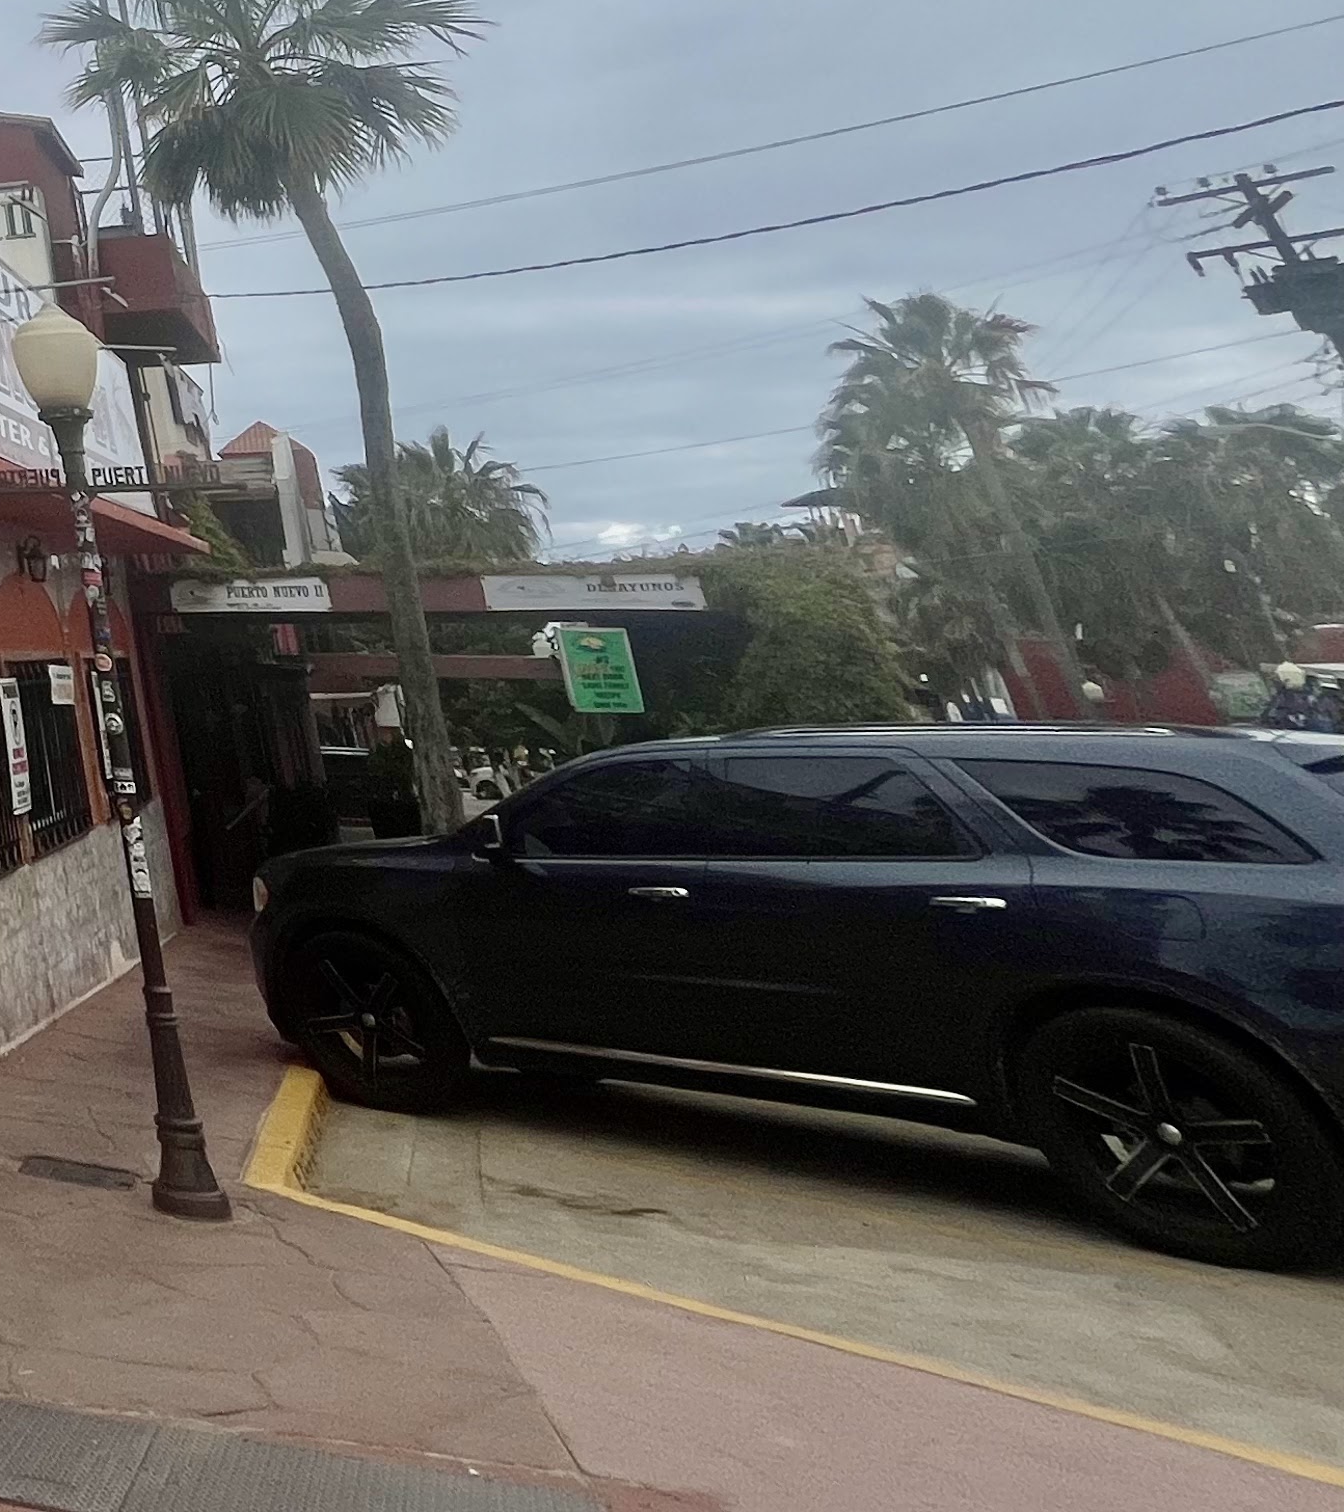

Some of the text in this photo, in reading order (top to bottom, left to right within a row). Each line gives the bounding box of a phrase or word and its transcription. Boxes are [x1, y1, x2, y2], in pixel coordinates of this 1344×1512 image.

[91, 465, 148, 487] PUERT
[226, 585, 268, 599] PUERTO
[273, 585, 309, 598] NUEVO
